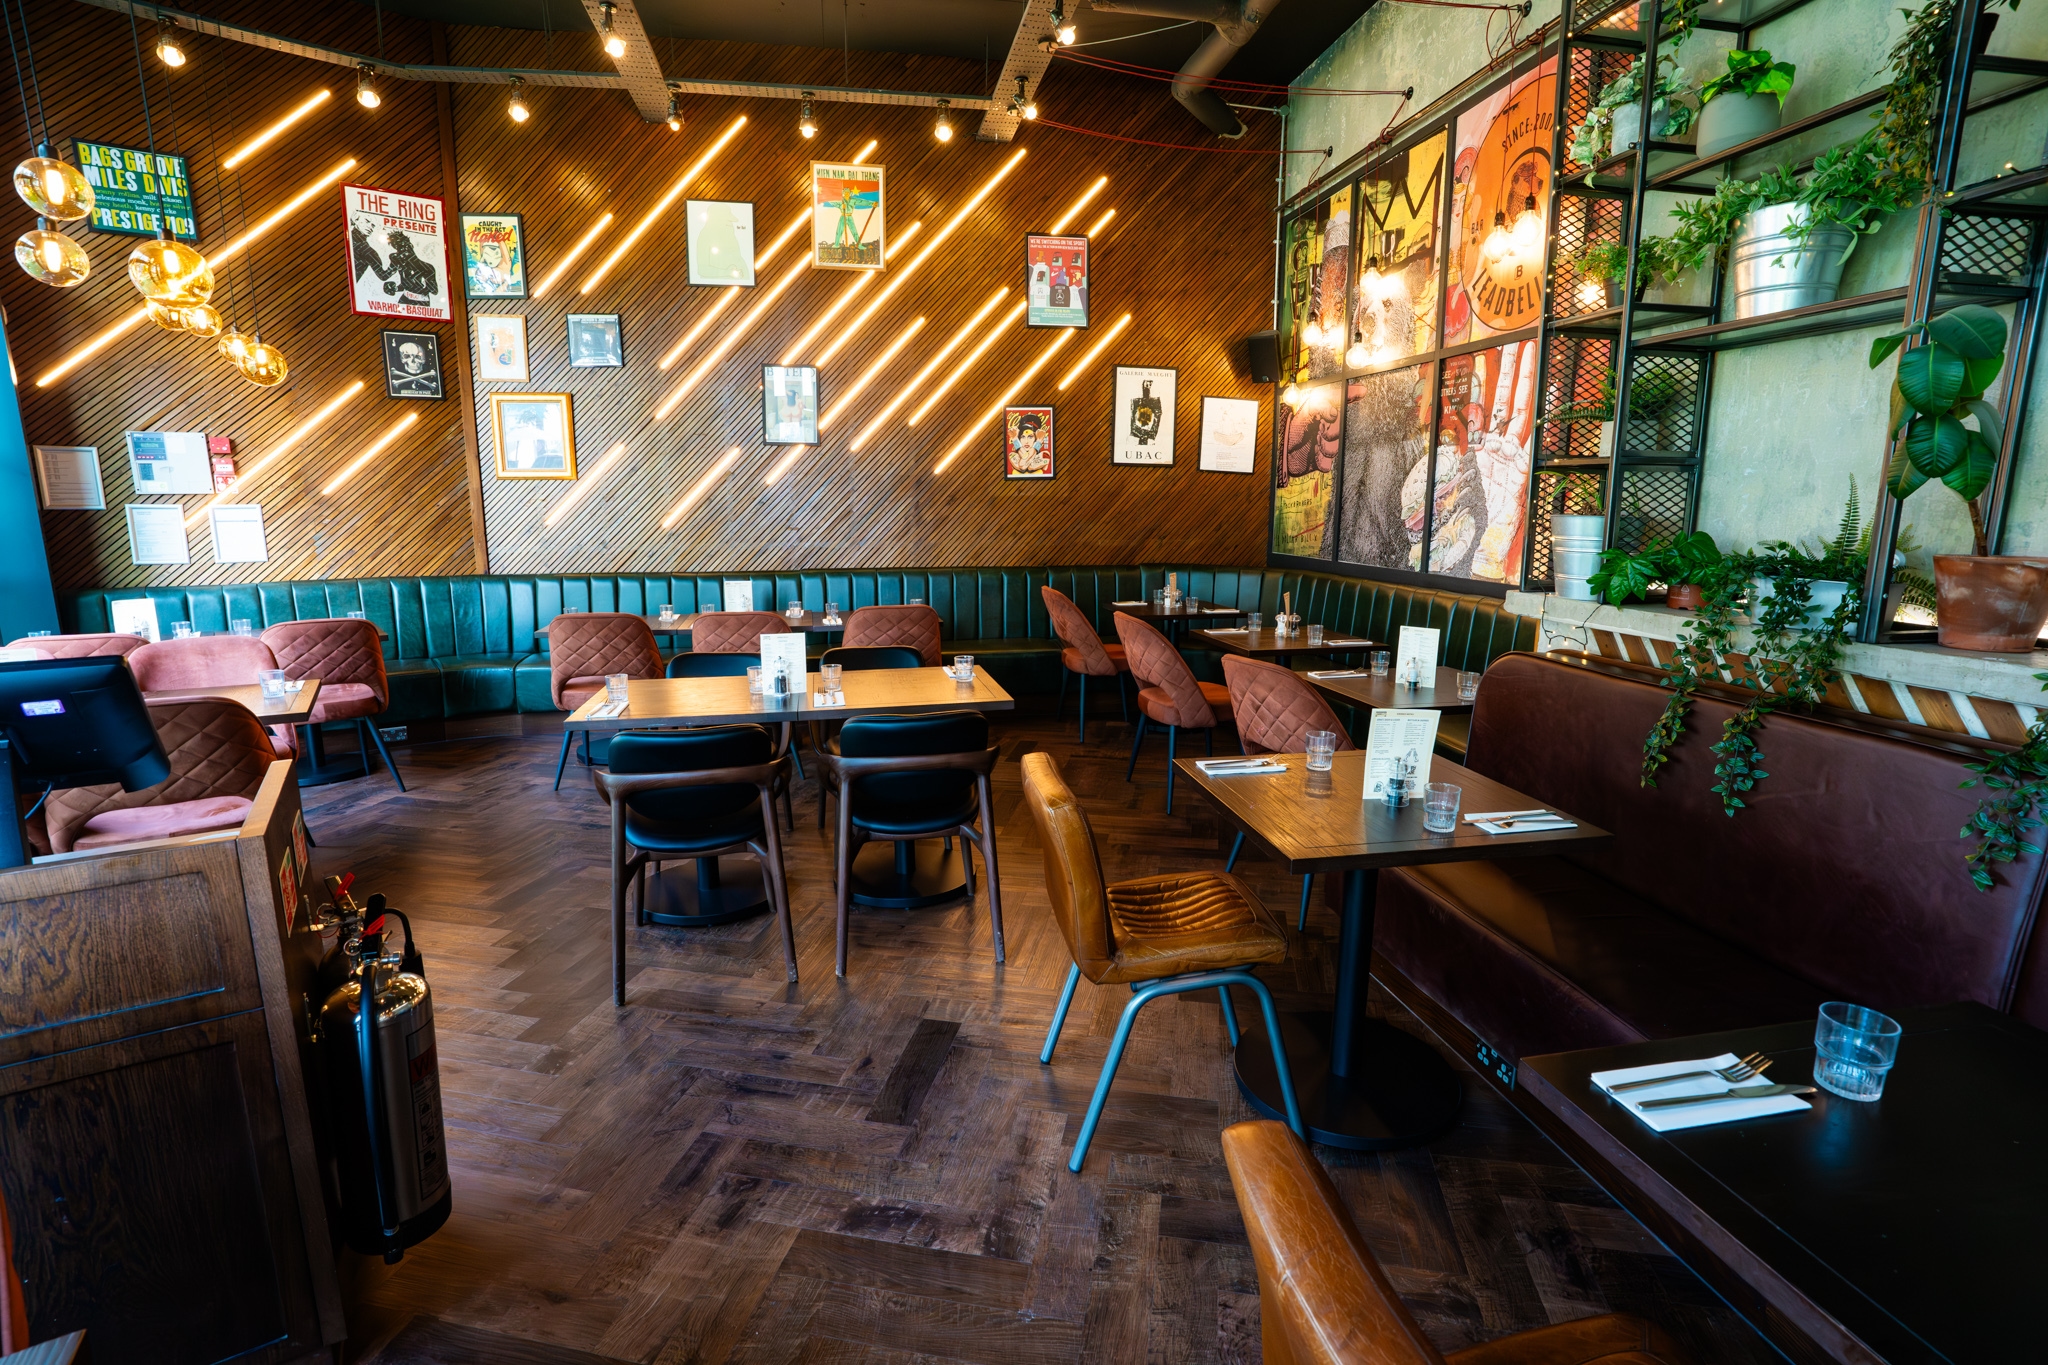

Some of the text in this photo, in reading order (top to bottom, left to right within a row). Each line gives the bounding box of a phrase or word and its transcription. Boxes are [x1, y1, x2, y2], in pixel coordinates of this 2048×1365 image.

[78, 143, 184, 178] BAGS GROOVE
[82, 164, 188, 198] MILES DAVIS
[358, 192, 436, 221] THE RING
[92, 207, 160, 232] PRESTIGE
[384, 218, 436, 234] PRESENTS
[1472, 219, 1484, 234] BAR
[1472, 268, 1543, 317] LEADBELL
[368, 300, 444, 318] WARHOL BASQUIAT
[1458, 384, 1468, 394] SEE
[1126, 451, 1162, 460] UBAC
